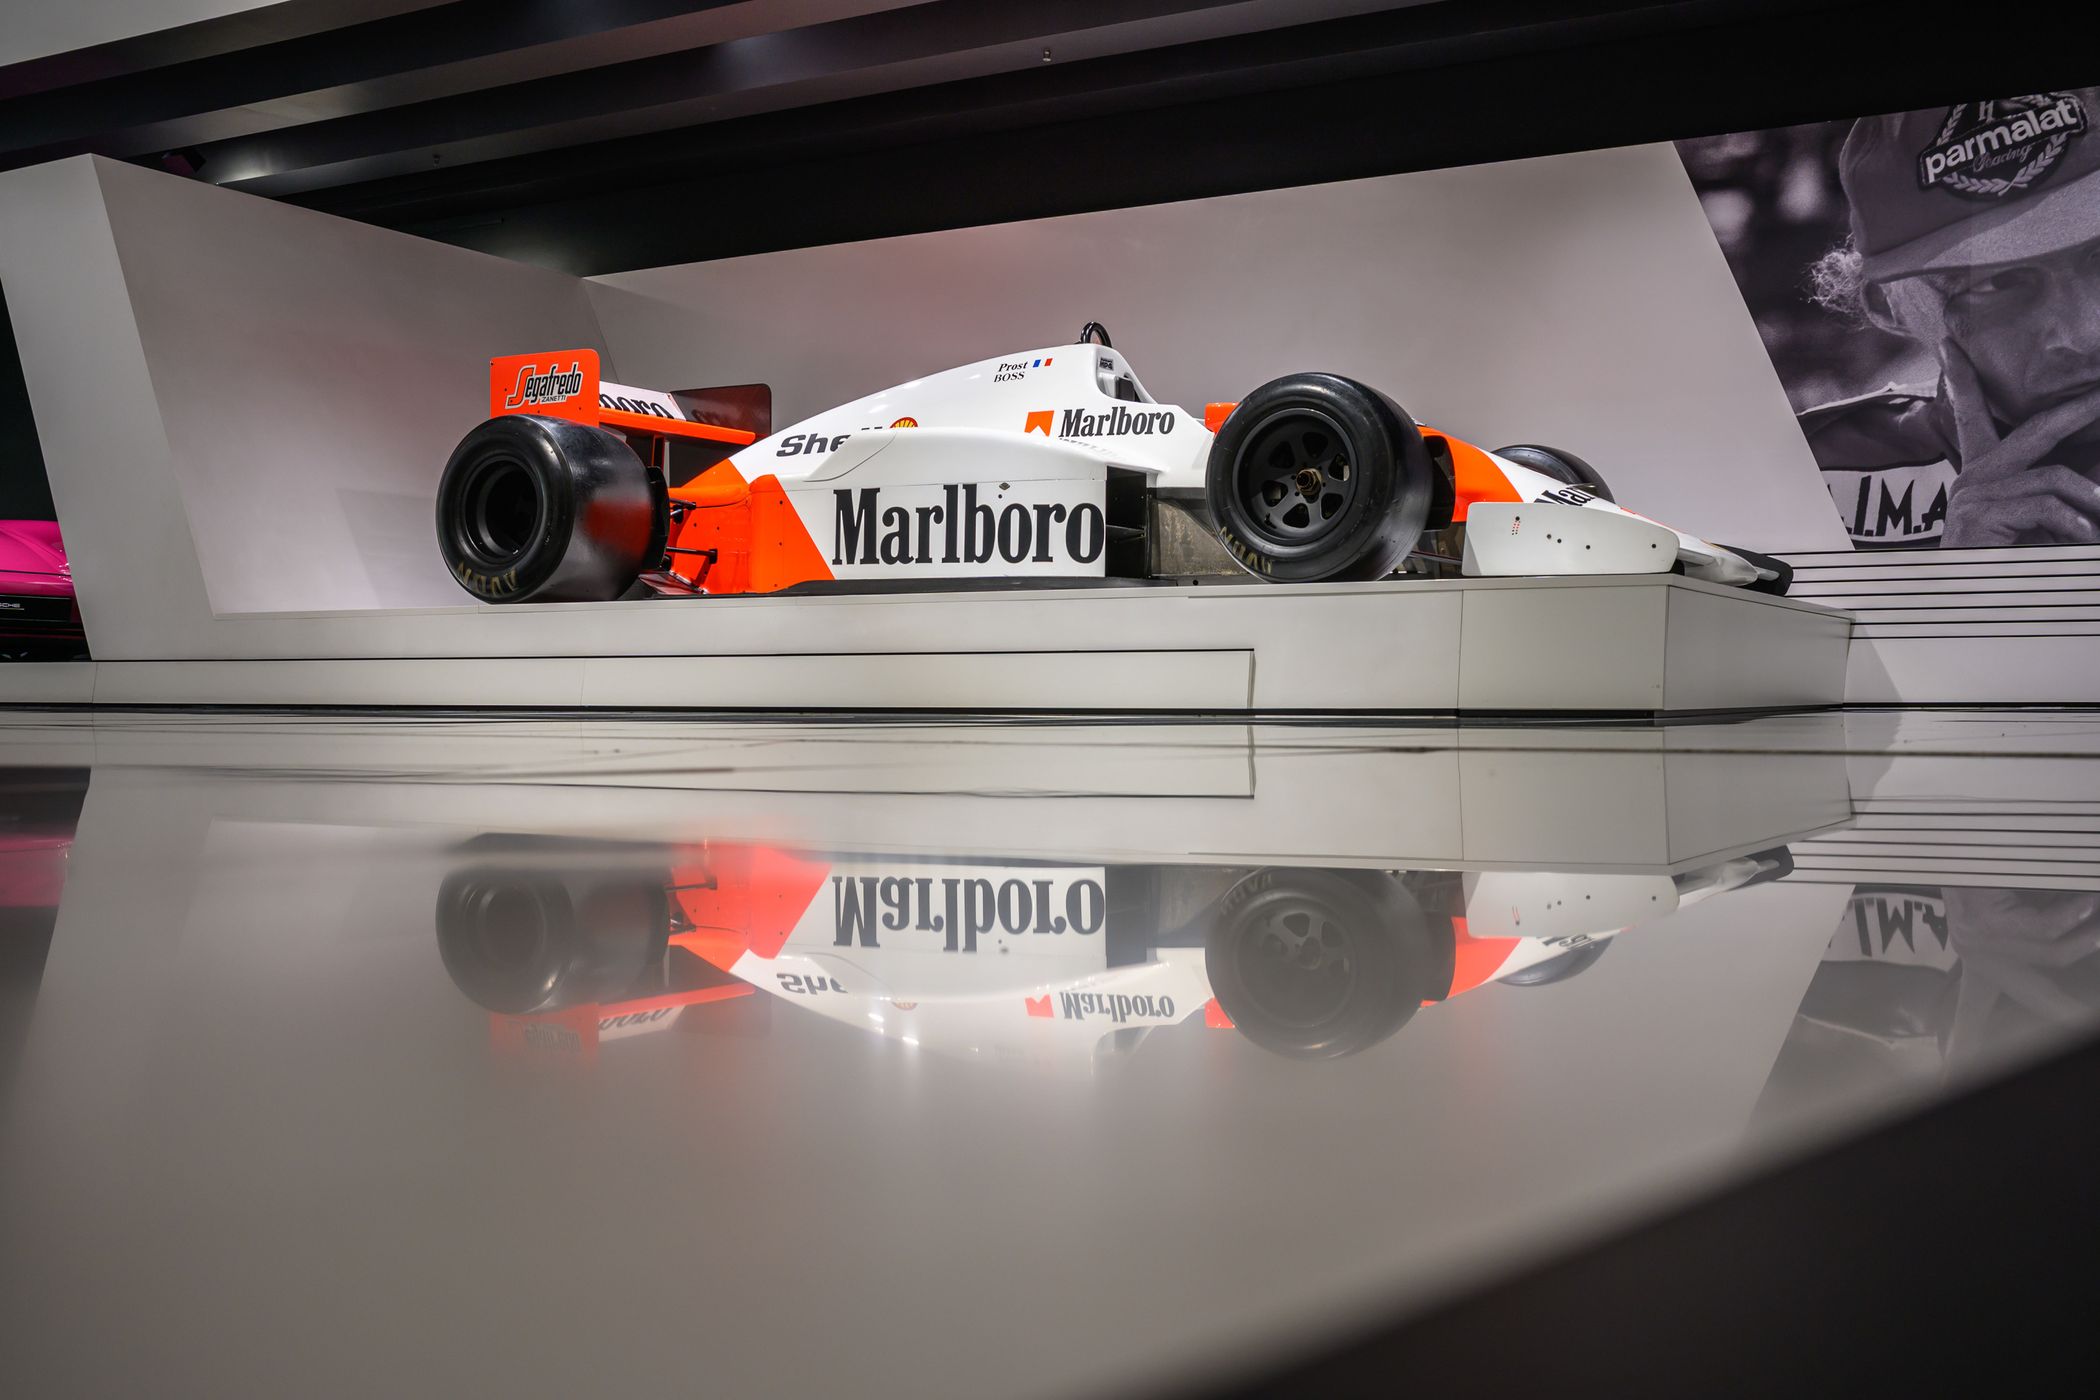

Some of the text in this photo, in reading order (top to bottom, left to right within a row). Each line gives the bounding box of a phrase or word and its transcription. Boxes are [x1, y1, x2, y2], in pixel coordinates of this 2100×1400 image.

[1924, 97, 2079, 184] parmalat
[993, 371, 1025, 383] BOSS
[998, 360, 1028, 372] Prost
[506, 362, 583, 408] Segafredo
[541, 395, 567, 403] ZANETTI
[1058, 405, 1176, 438] Marlboro
[776, 426, 883, 458] She
[831, 483, 1106, 566] Marlboro
